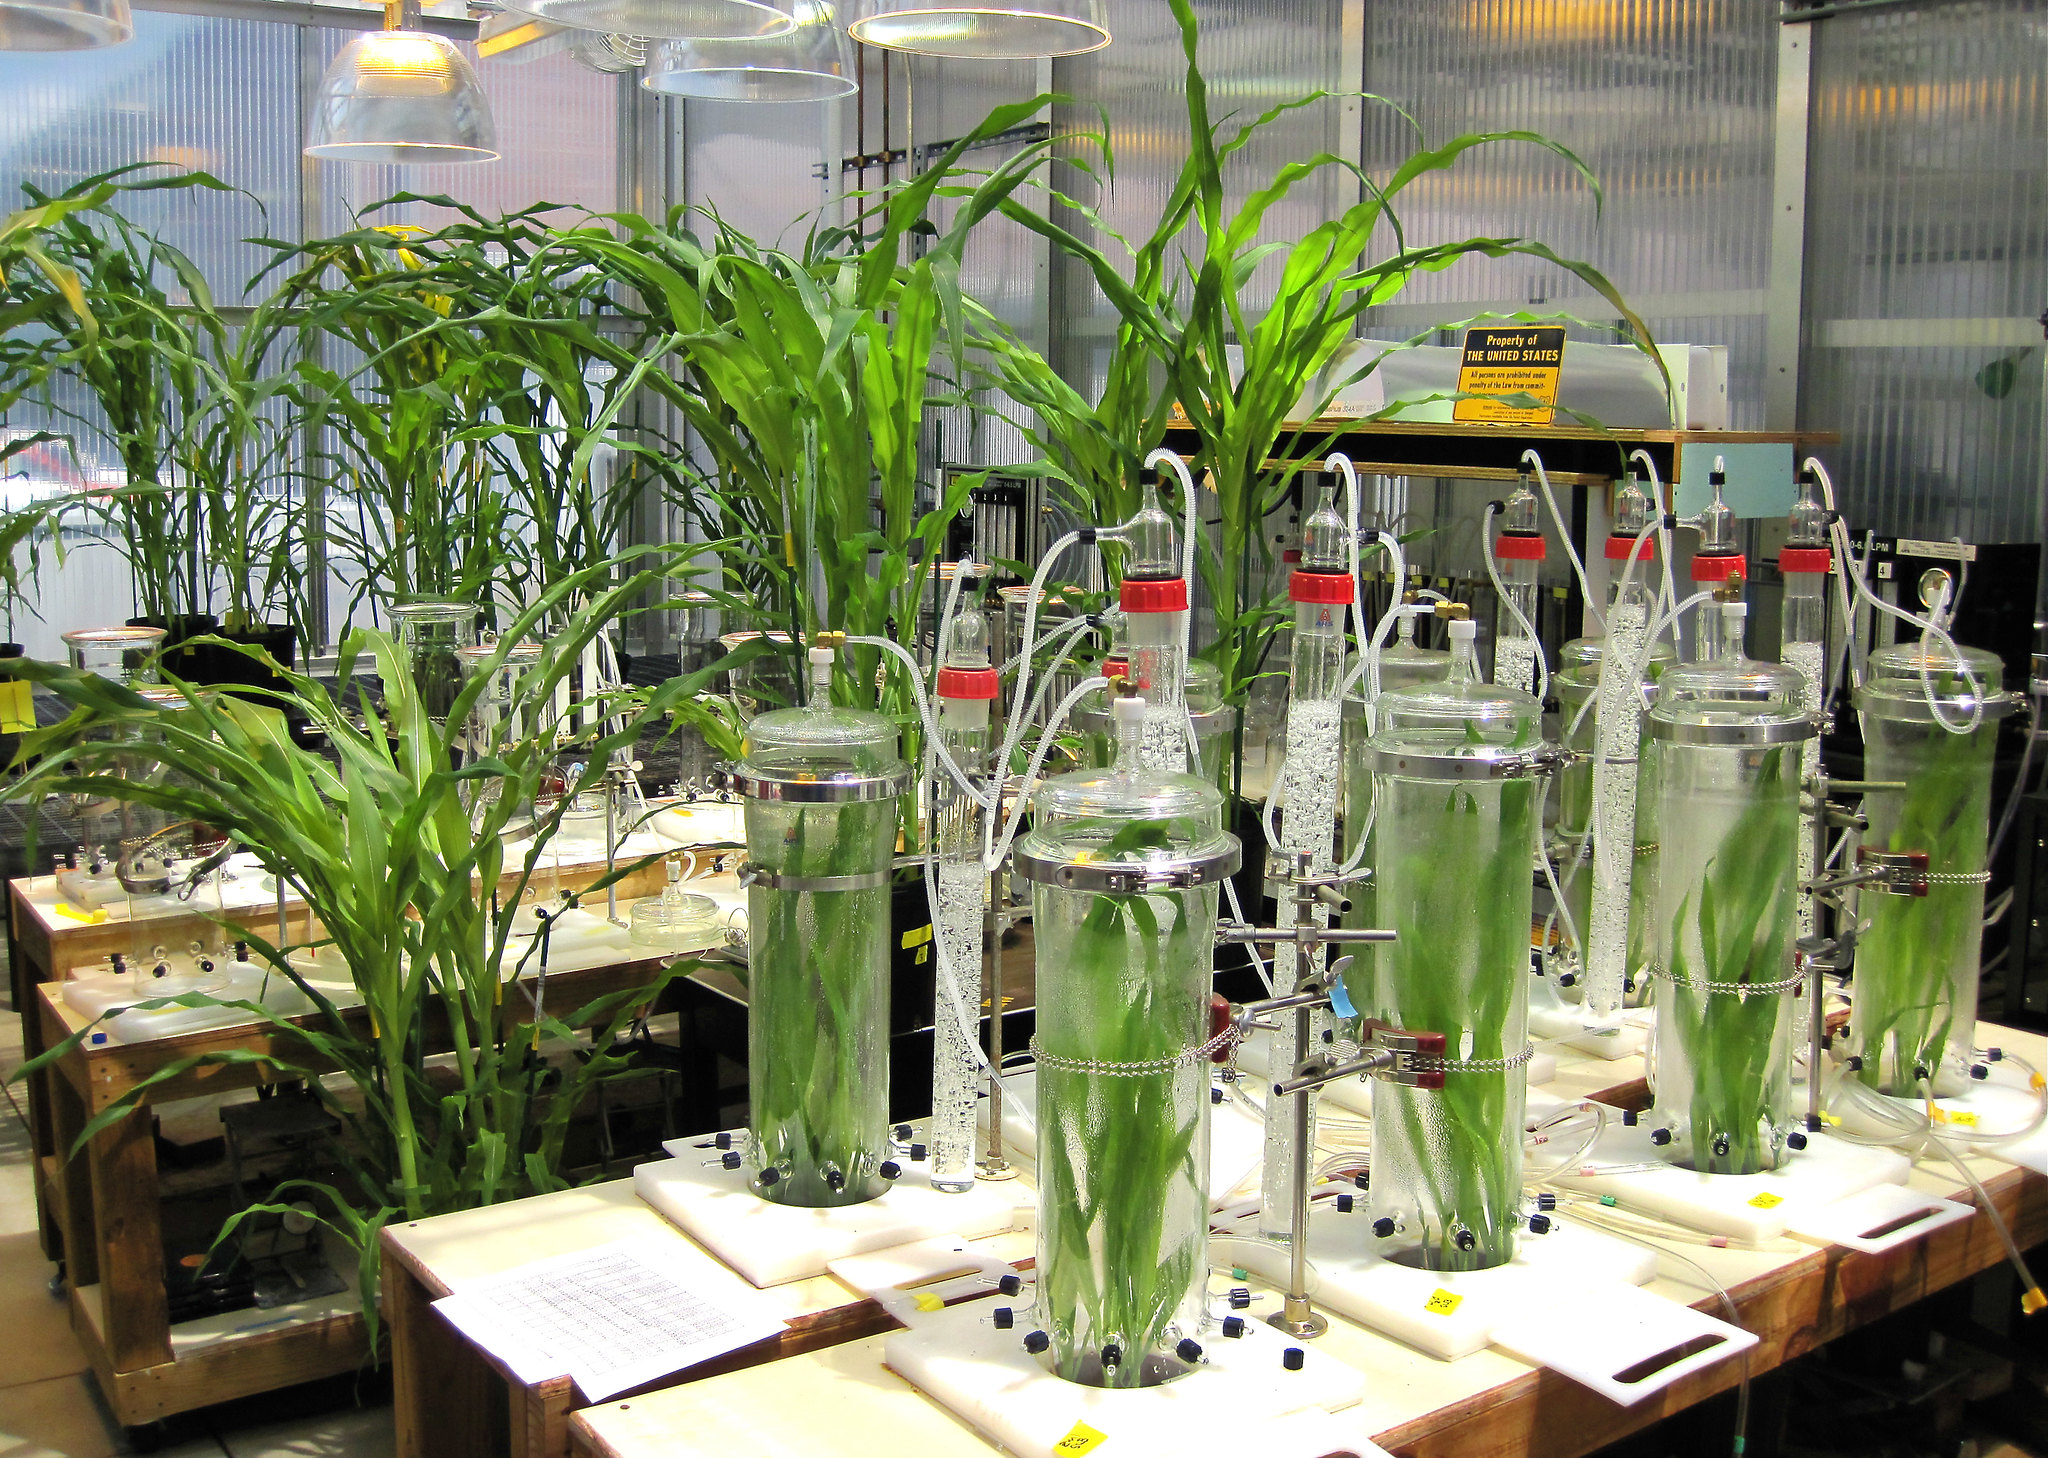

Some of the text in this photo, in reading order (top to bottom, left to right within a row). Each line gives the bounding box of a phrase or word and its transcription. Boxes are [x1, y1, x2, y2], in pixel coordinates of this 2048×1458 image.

[1486, 334, 1538, 348] Property of
[1467, 349, 1559, 361] THE UNITED STATES
[1470, 371, 1479, 379] All
[1506, 371, 1531, 380] prohibited
[1532, 371, 1547, 379] under
[1469, 381, 1487, 390] penalty
[1487, 381, 1494, 389] of
[1502, 381, 1512, 389] Law
[1512, 381, 1524, 389] from
[1525, 382, 1546, 390] commit-
[1870, 542, 1889, 552] LPM
[1879, 566, 1885, 575] 4
